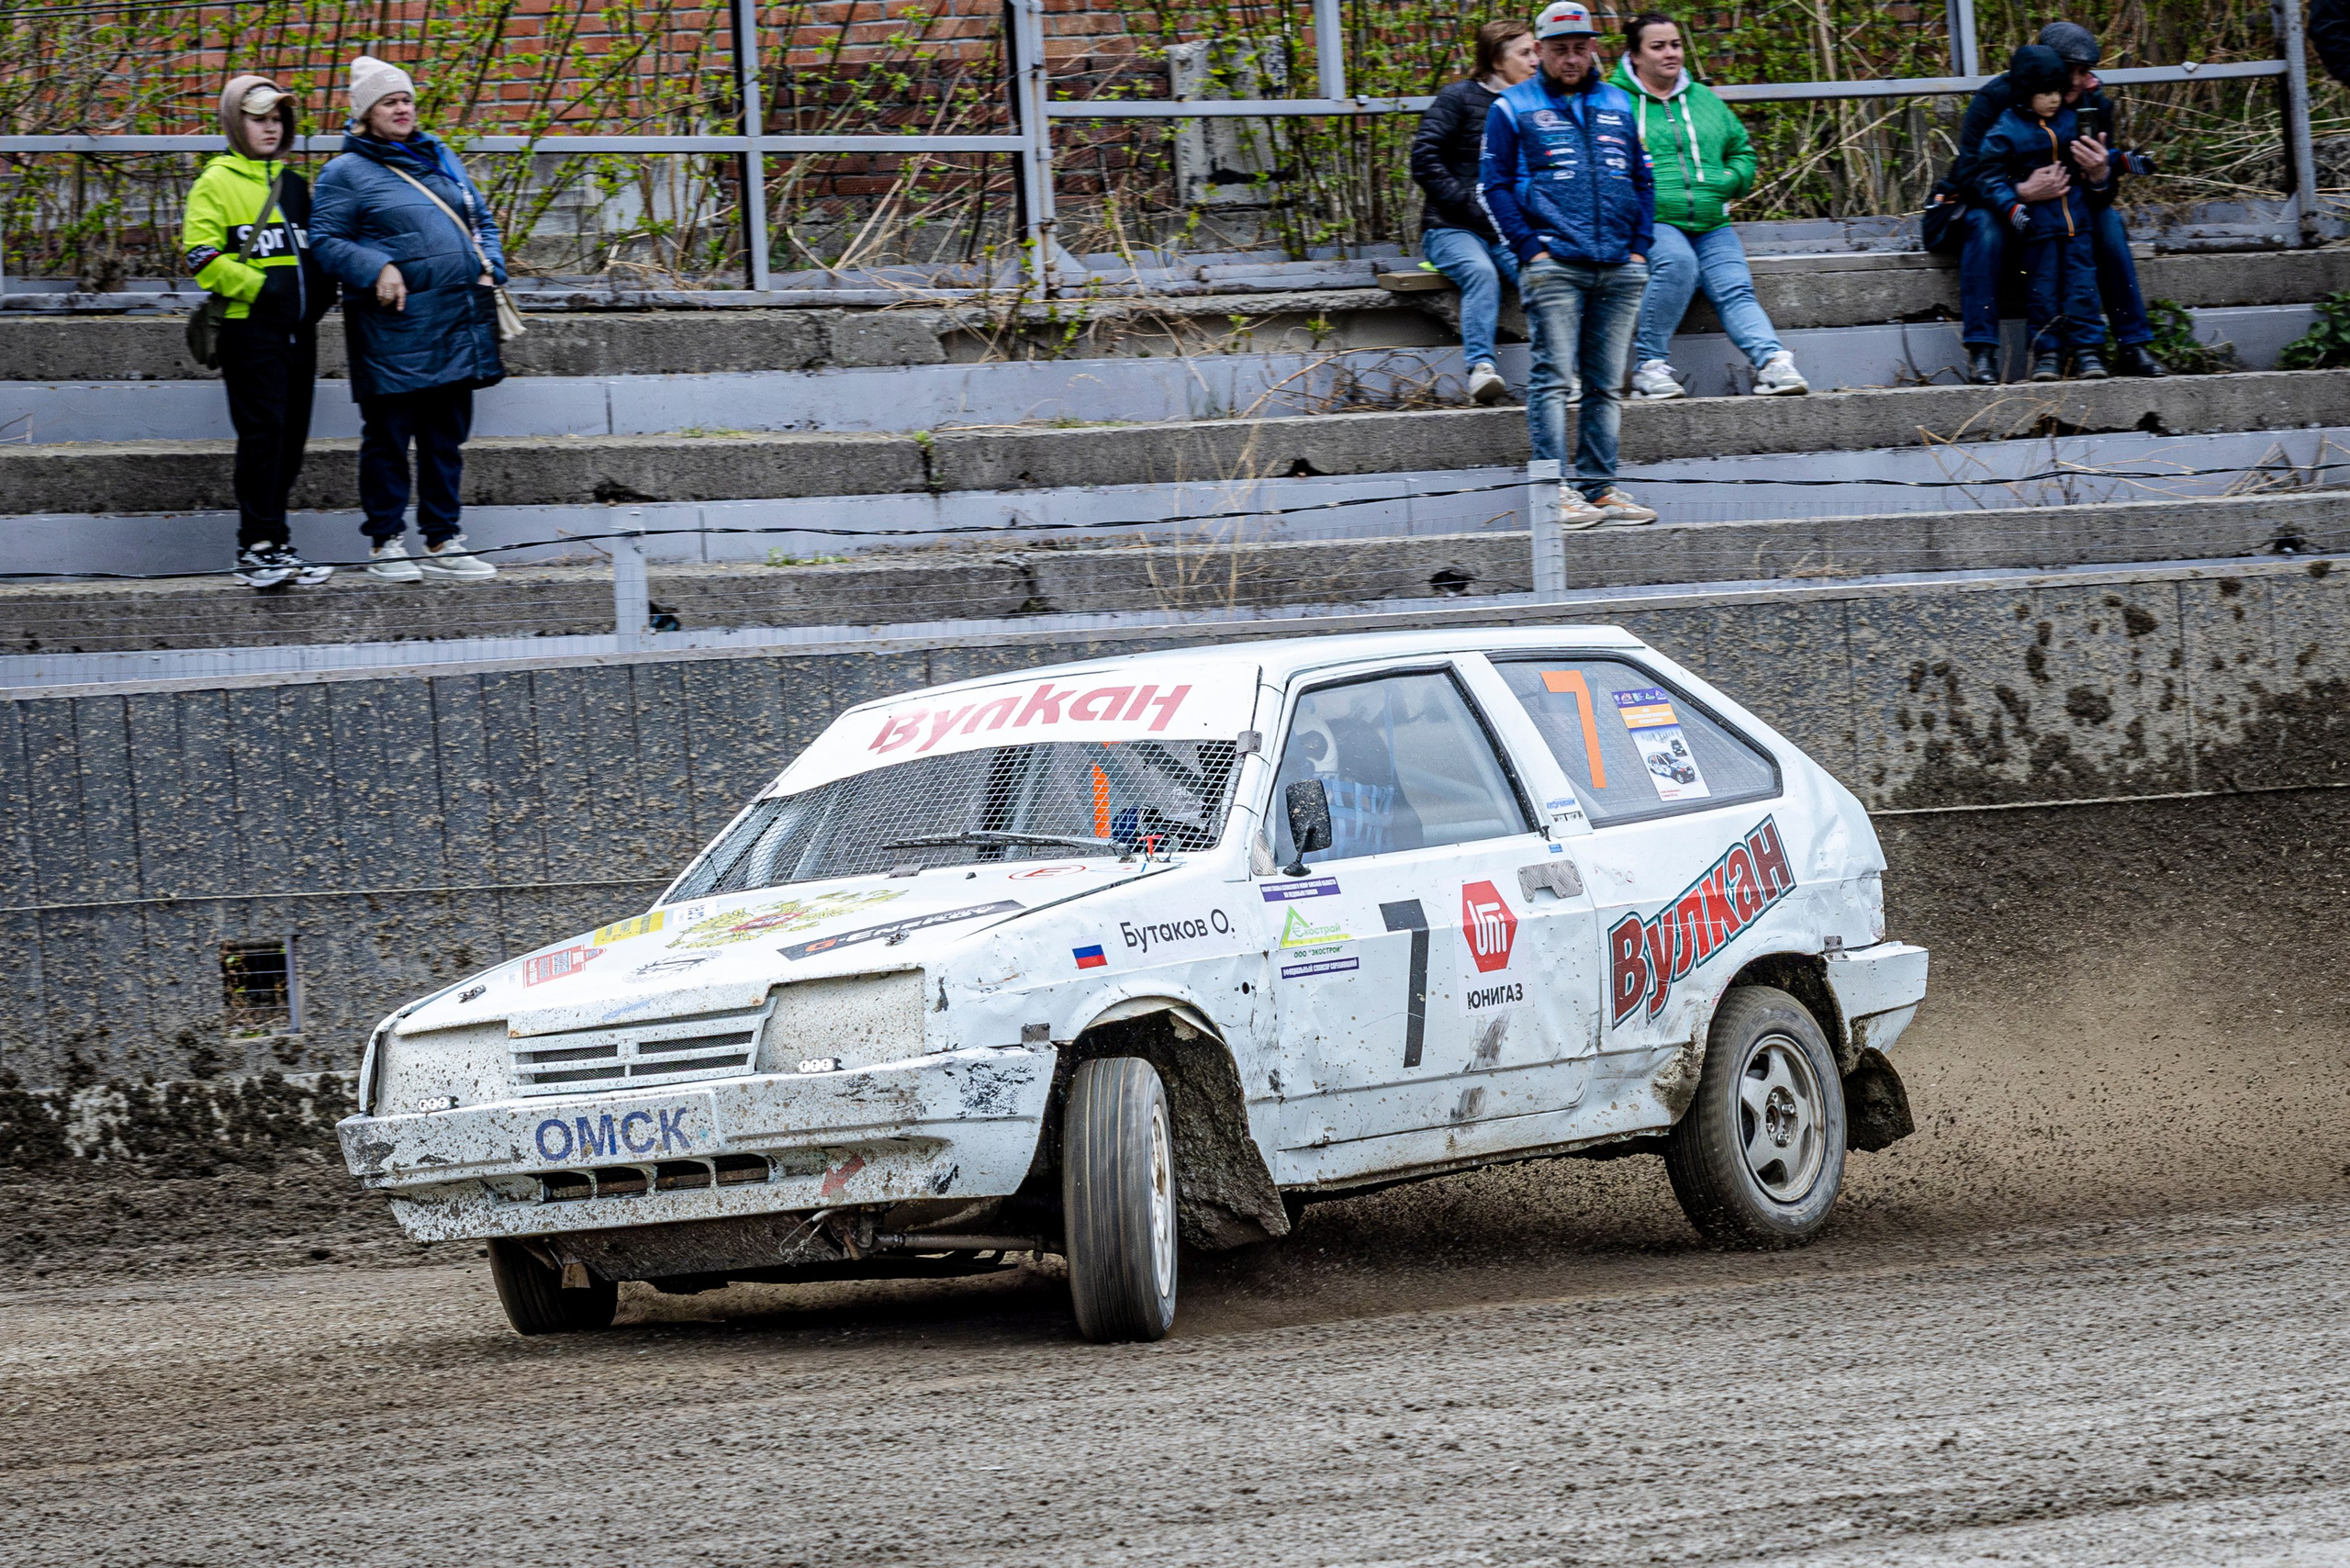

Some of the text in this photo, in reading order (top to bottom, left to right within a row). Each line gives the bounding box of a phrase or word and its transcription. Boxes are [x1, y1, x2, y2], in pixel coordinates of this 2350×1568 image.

[1540, 670, 1606, 789] 7
[1120, 908, 1236, 953] Бутаков О.
[1293, 950, 1307, 958] ООО
[1467, 982, 1524, 1010] ЮНИГАЗ
[535, 1107, 692, 1161] ОМСК
